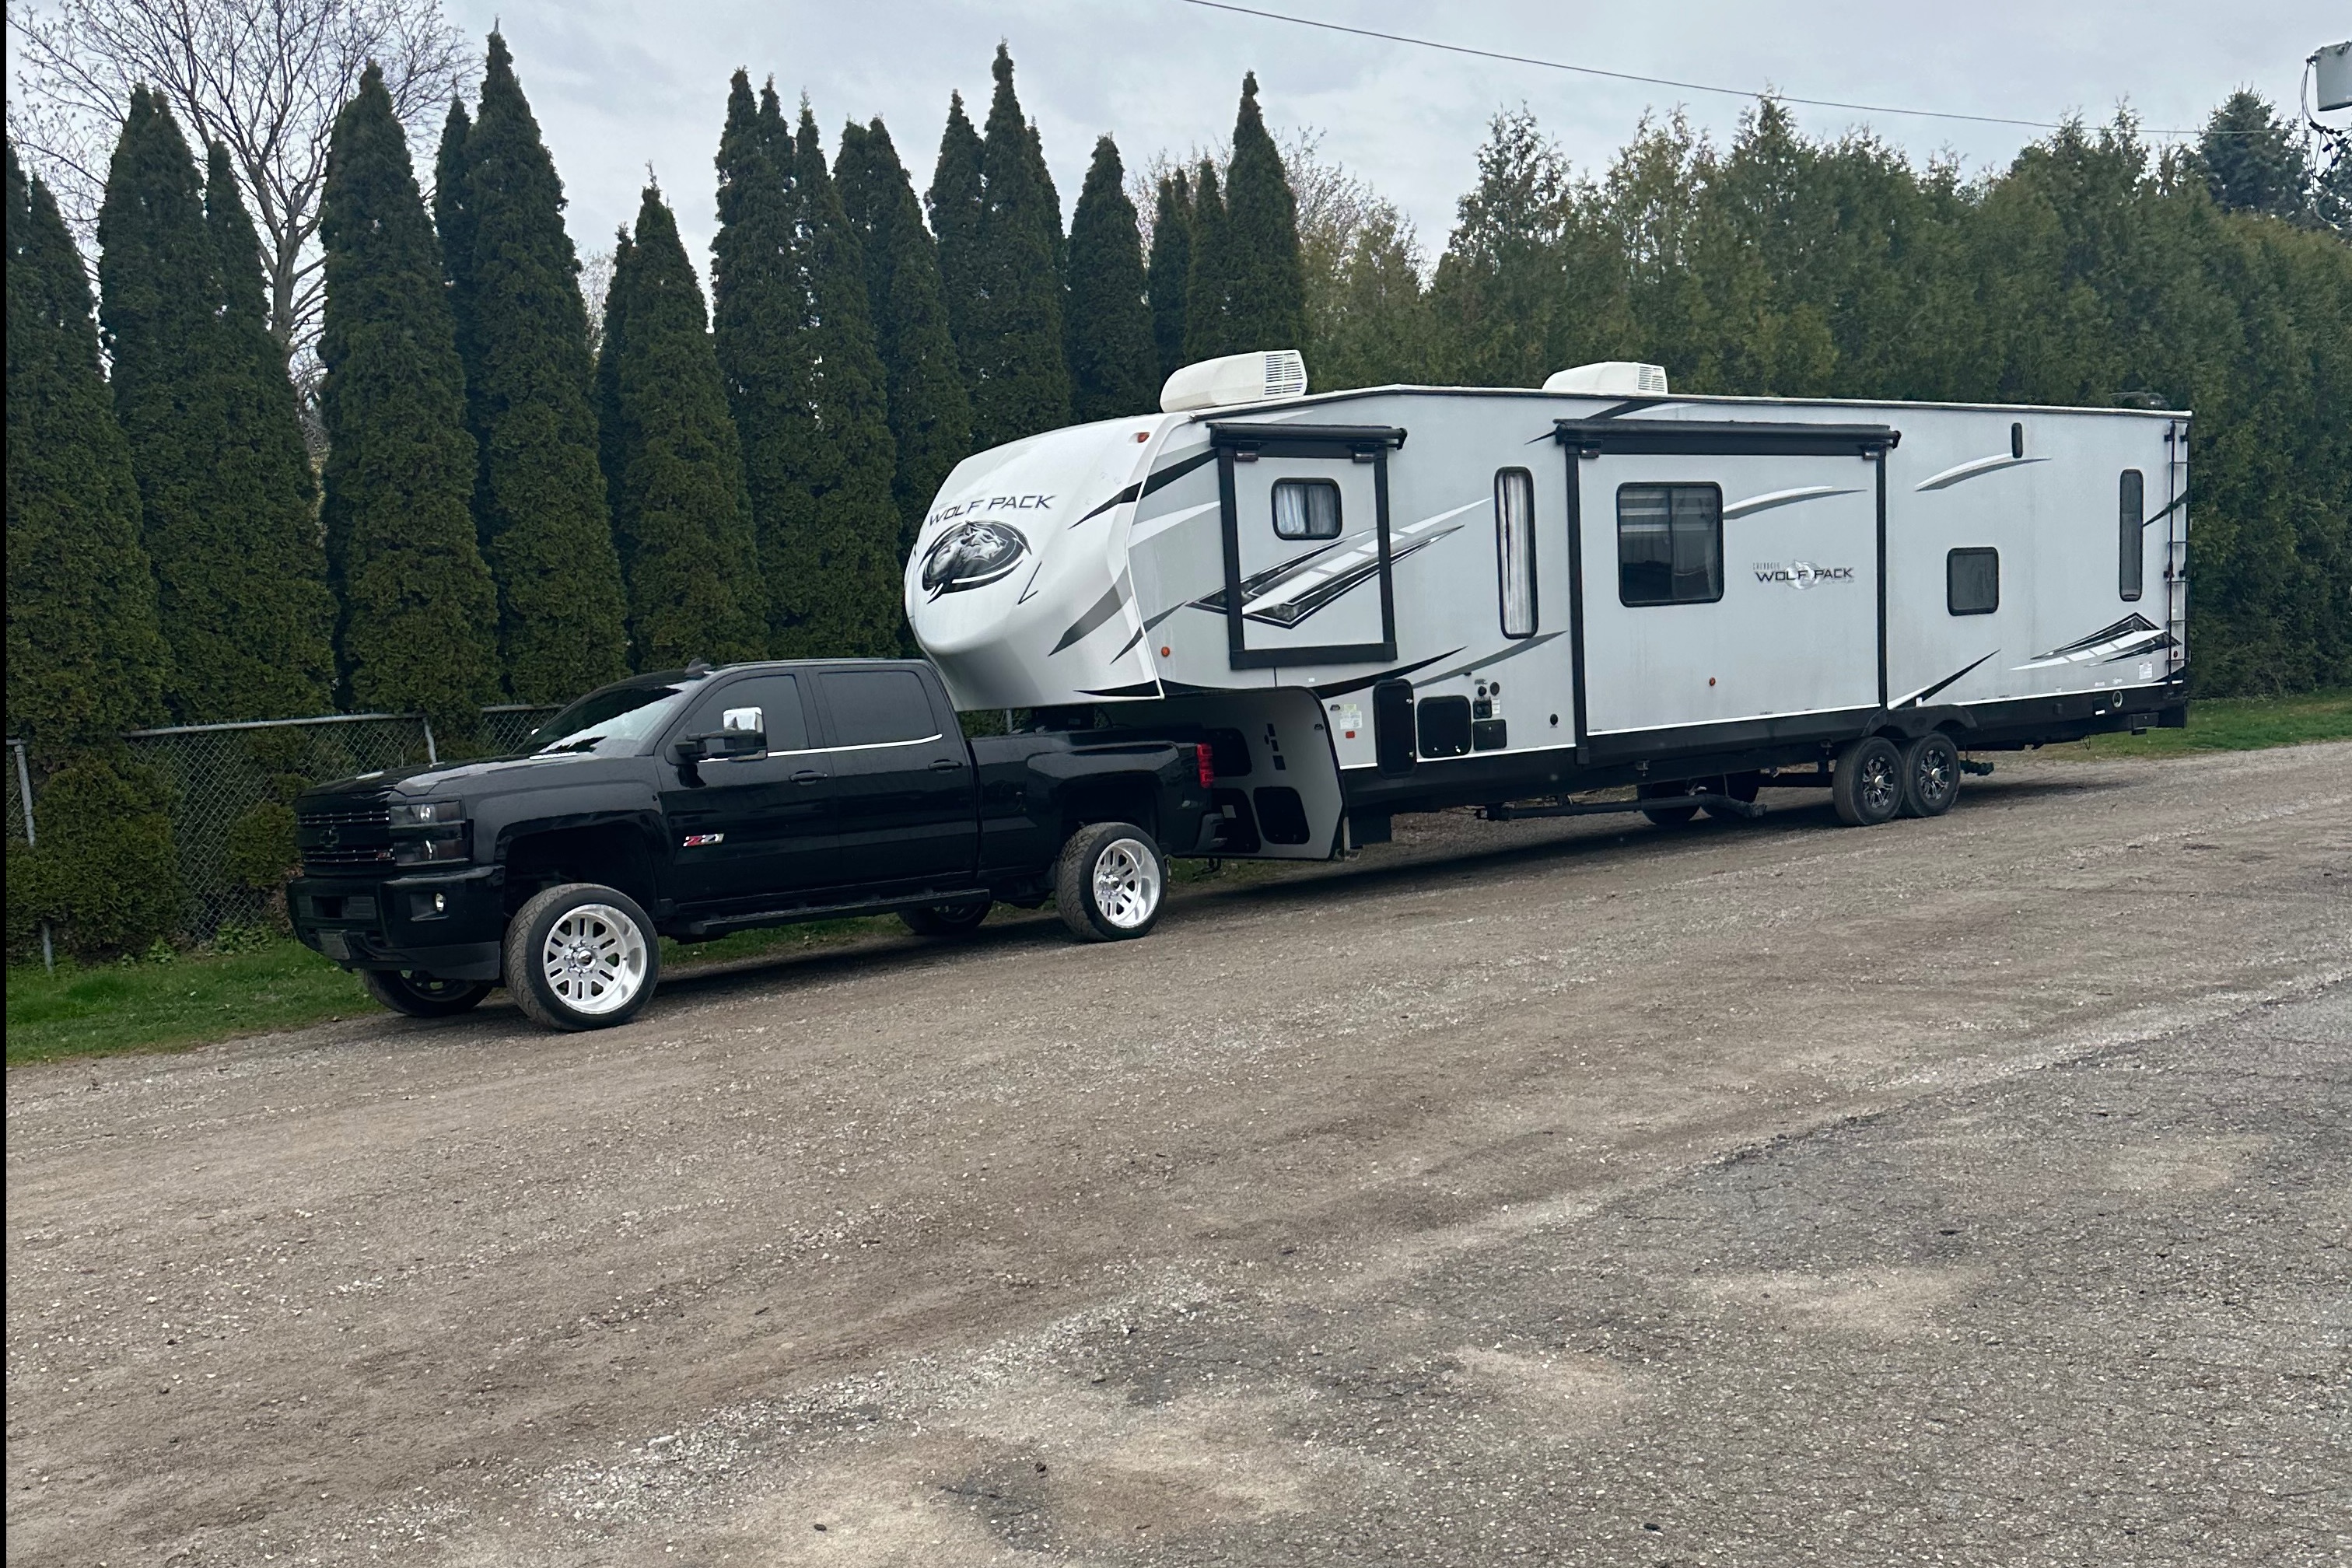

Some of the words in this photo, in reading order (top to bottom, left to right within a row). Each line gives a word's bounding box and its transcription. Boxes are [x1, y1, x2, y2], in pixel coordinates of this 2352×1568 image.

[929, 499, 984, 526] WOLF
[988, 495, 1056, 509] PACK
[1755, 570, 1808, 582] WOLF
[1814, 568, 1853, 579] PACK
